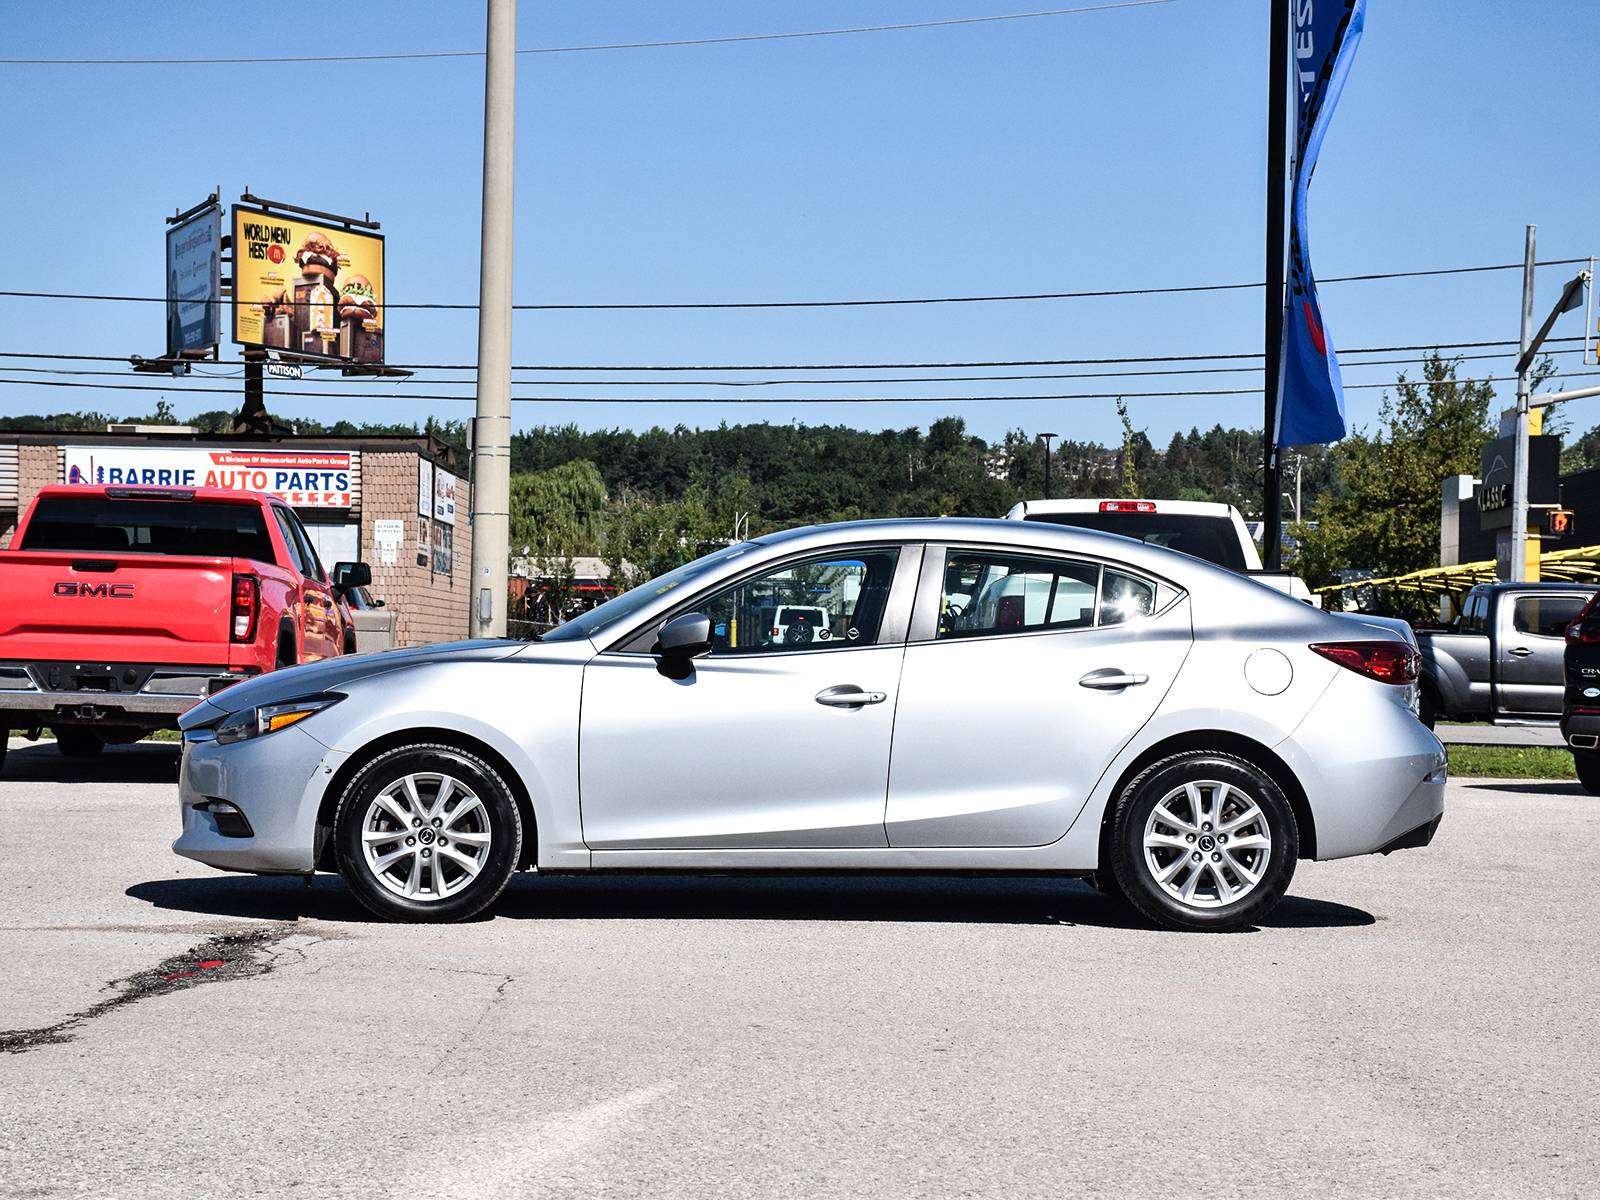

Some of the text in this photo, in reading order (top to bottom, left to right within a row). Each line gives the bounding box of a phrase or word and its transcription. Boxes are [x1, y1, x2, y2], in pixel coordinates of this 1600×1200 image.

[243, 223, 291, 245] WORLD MENU
[269, 364, 301, 378] PATTISON
[330, 458, 348, 466] Group
[109, 467, 349, 491] BARRIE AUTO PARTS
[53, 582, 135, 599] GMC
